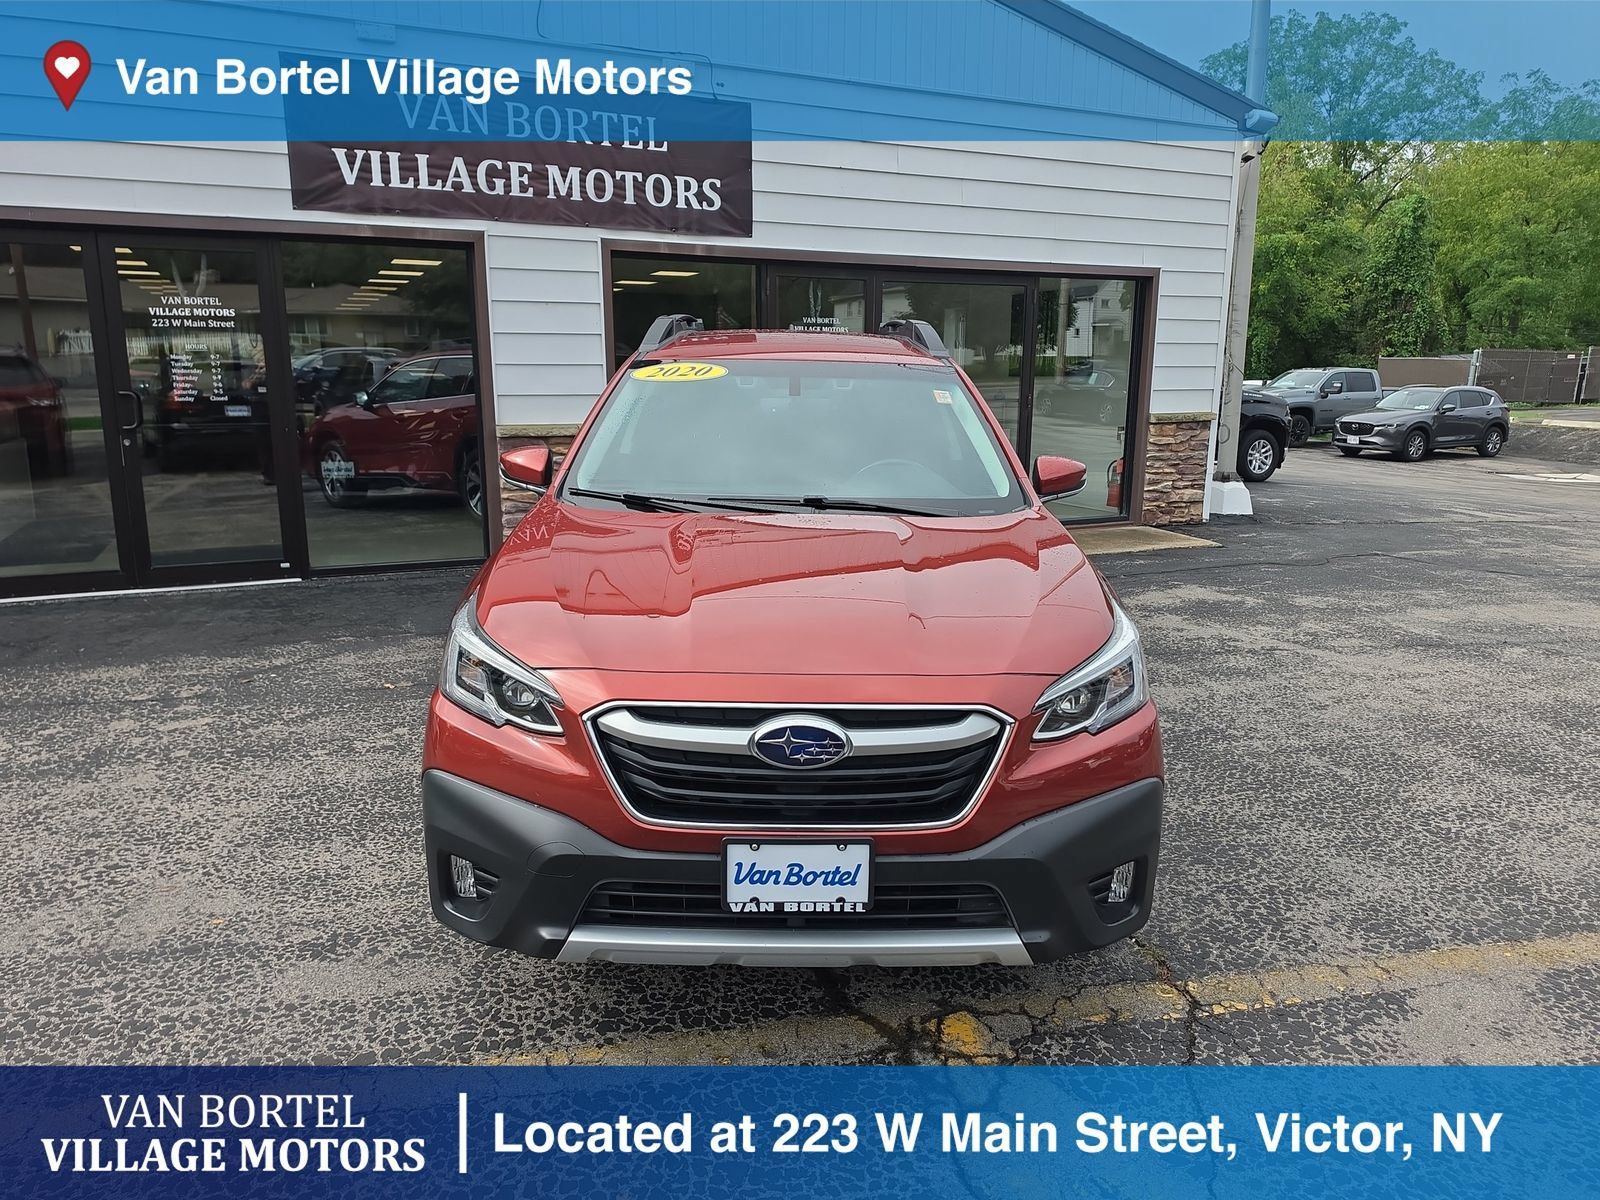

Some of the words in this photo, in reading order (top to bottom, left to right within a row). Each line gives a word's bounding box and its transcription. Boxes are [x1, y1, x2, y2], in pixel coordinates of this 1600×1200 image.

[394, 91, 489, 136] VAN
[504, 101, 668, 152] BORTEL
[331, 147, 534, 198] VILLAGE
[545, 163, 722, 212] MOTORS
[161, 296, 182, 305] VAN
[183, 296, 222, 306] BORTEL
[148, 307, 192, 316] VILLAGE
[193, 308, 236, 317] MOTORS
[152, 319, 170, 327] 223
[171, 319, 182, 327] W
[184, 319, 206, 328] Main
[208, 319, 235, 328] Street
[802, 316, 816, 324] VAN
[816, 317, 841, 325] BORTEL
[646, 366, 713, 378] 2020
[734, 862, 782, 886] Van
[782, 862, 863, 887] Bortel
[729, 902, 775, 912] VAN
[784, 902, 866, 912] BORTEL
